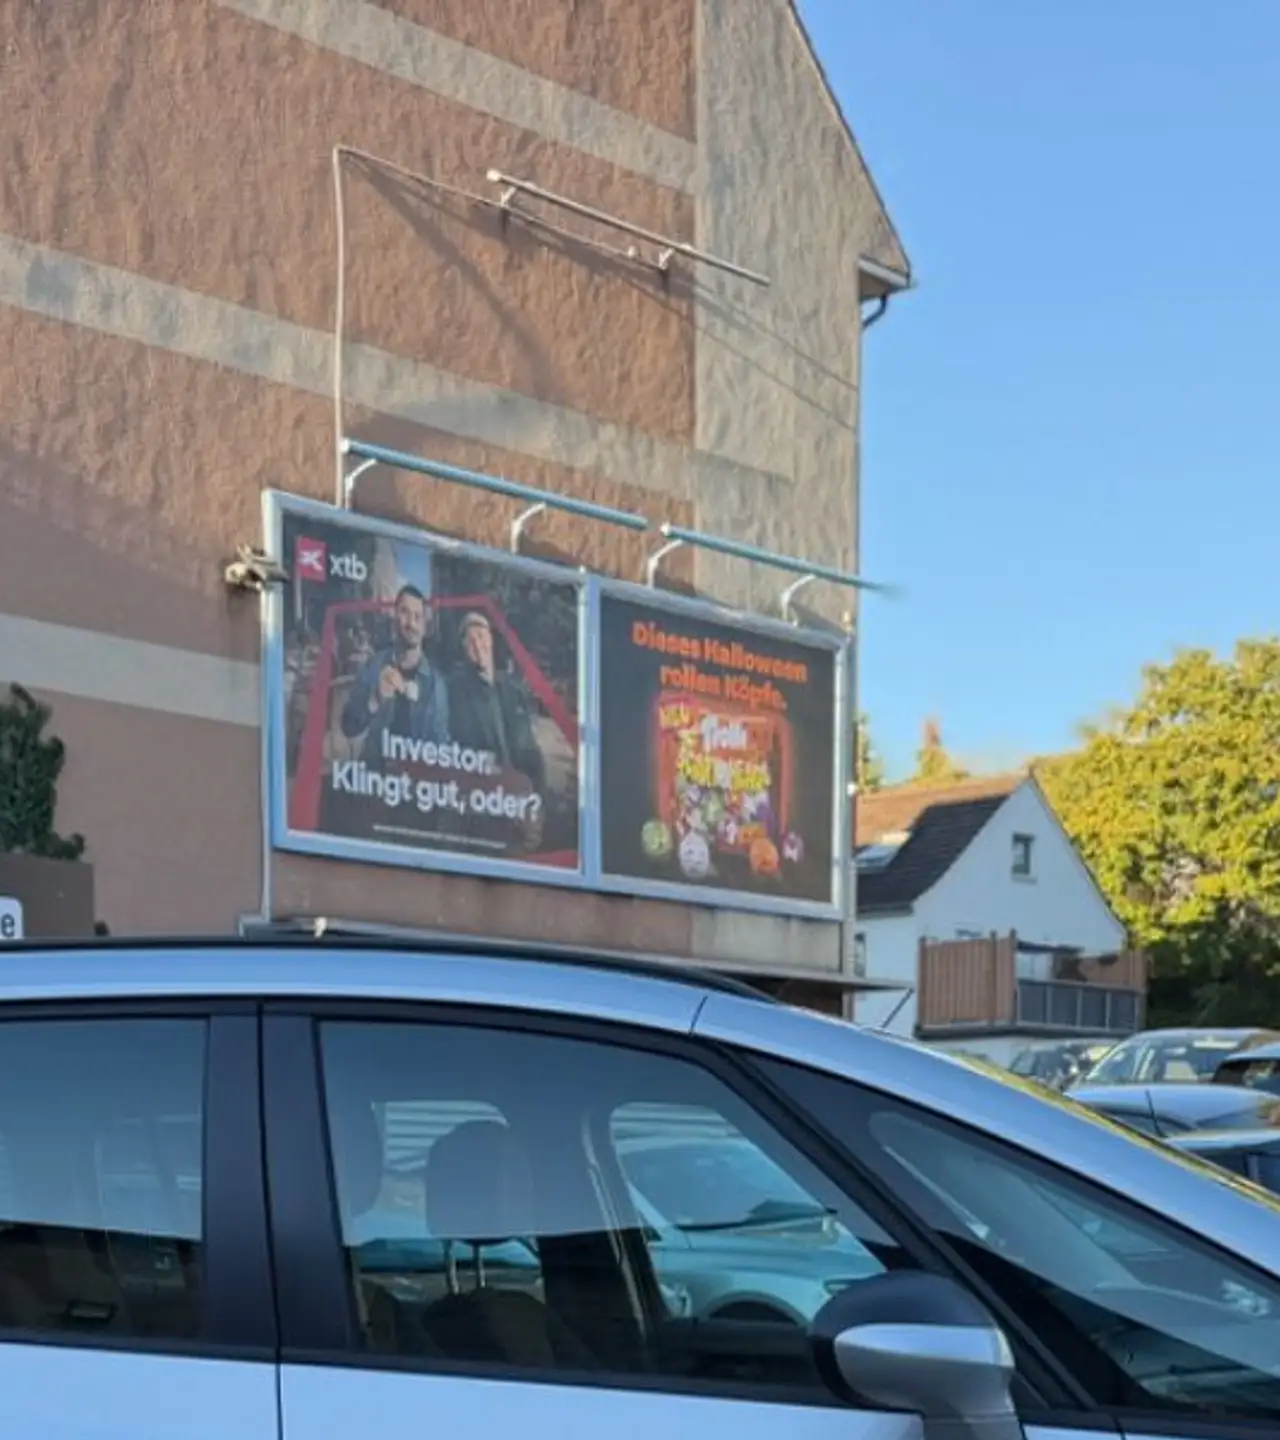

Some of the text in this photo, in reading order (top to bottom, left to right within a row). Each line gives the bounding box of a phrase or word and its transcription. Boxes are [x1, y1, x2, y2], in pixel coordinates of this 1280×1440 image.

[330, 552, 368, 582] xtb
[632, 620, 701, 659] Dieses
[660, 661, 720, 695] rollen
[332, 759, 542, 822] Klingt gut, oder?
